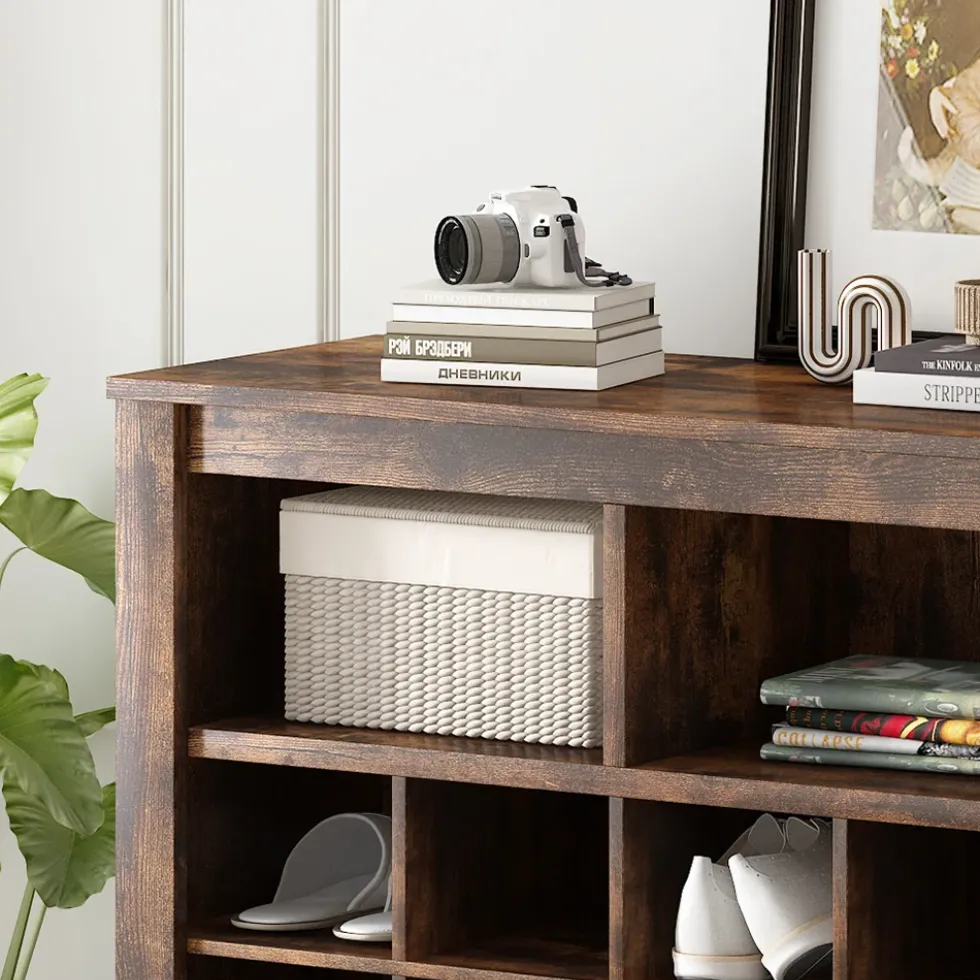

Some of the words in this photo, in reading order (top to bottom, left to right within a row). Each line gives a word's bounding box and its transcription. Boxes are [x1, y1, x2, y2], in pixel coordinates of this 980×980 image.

[388, 335, 411, 355] РЭЙ
[415, 339, 472, 358] БРЭДБЕРИ
[922, 360, 936, 370] THE
[936, 359, 973, 372] KINFOLK
[438, 368, 521, 382] ДНЕВНИКИ
